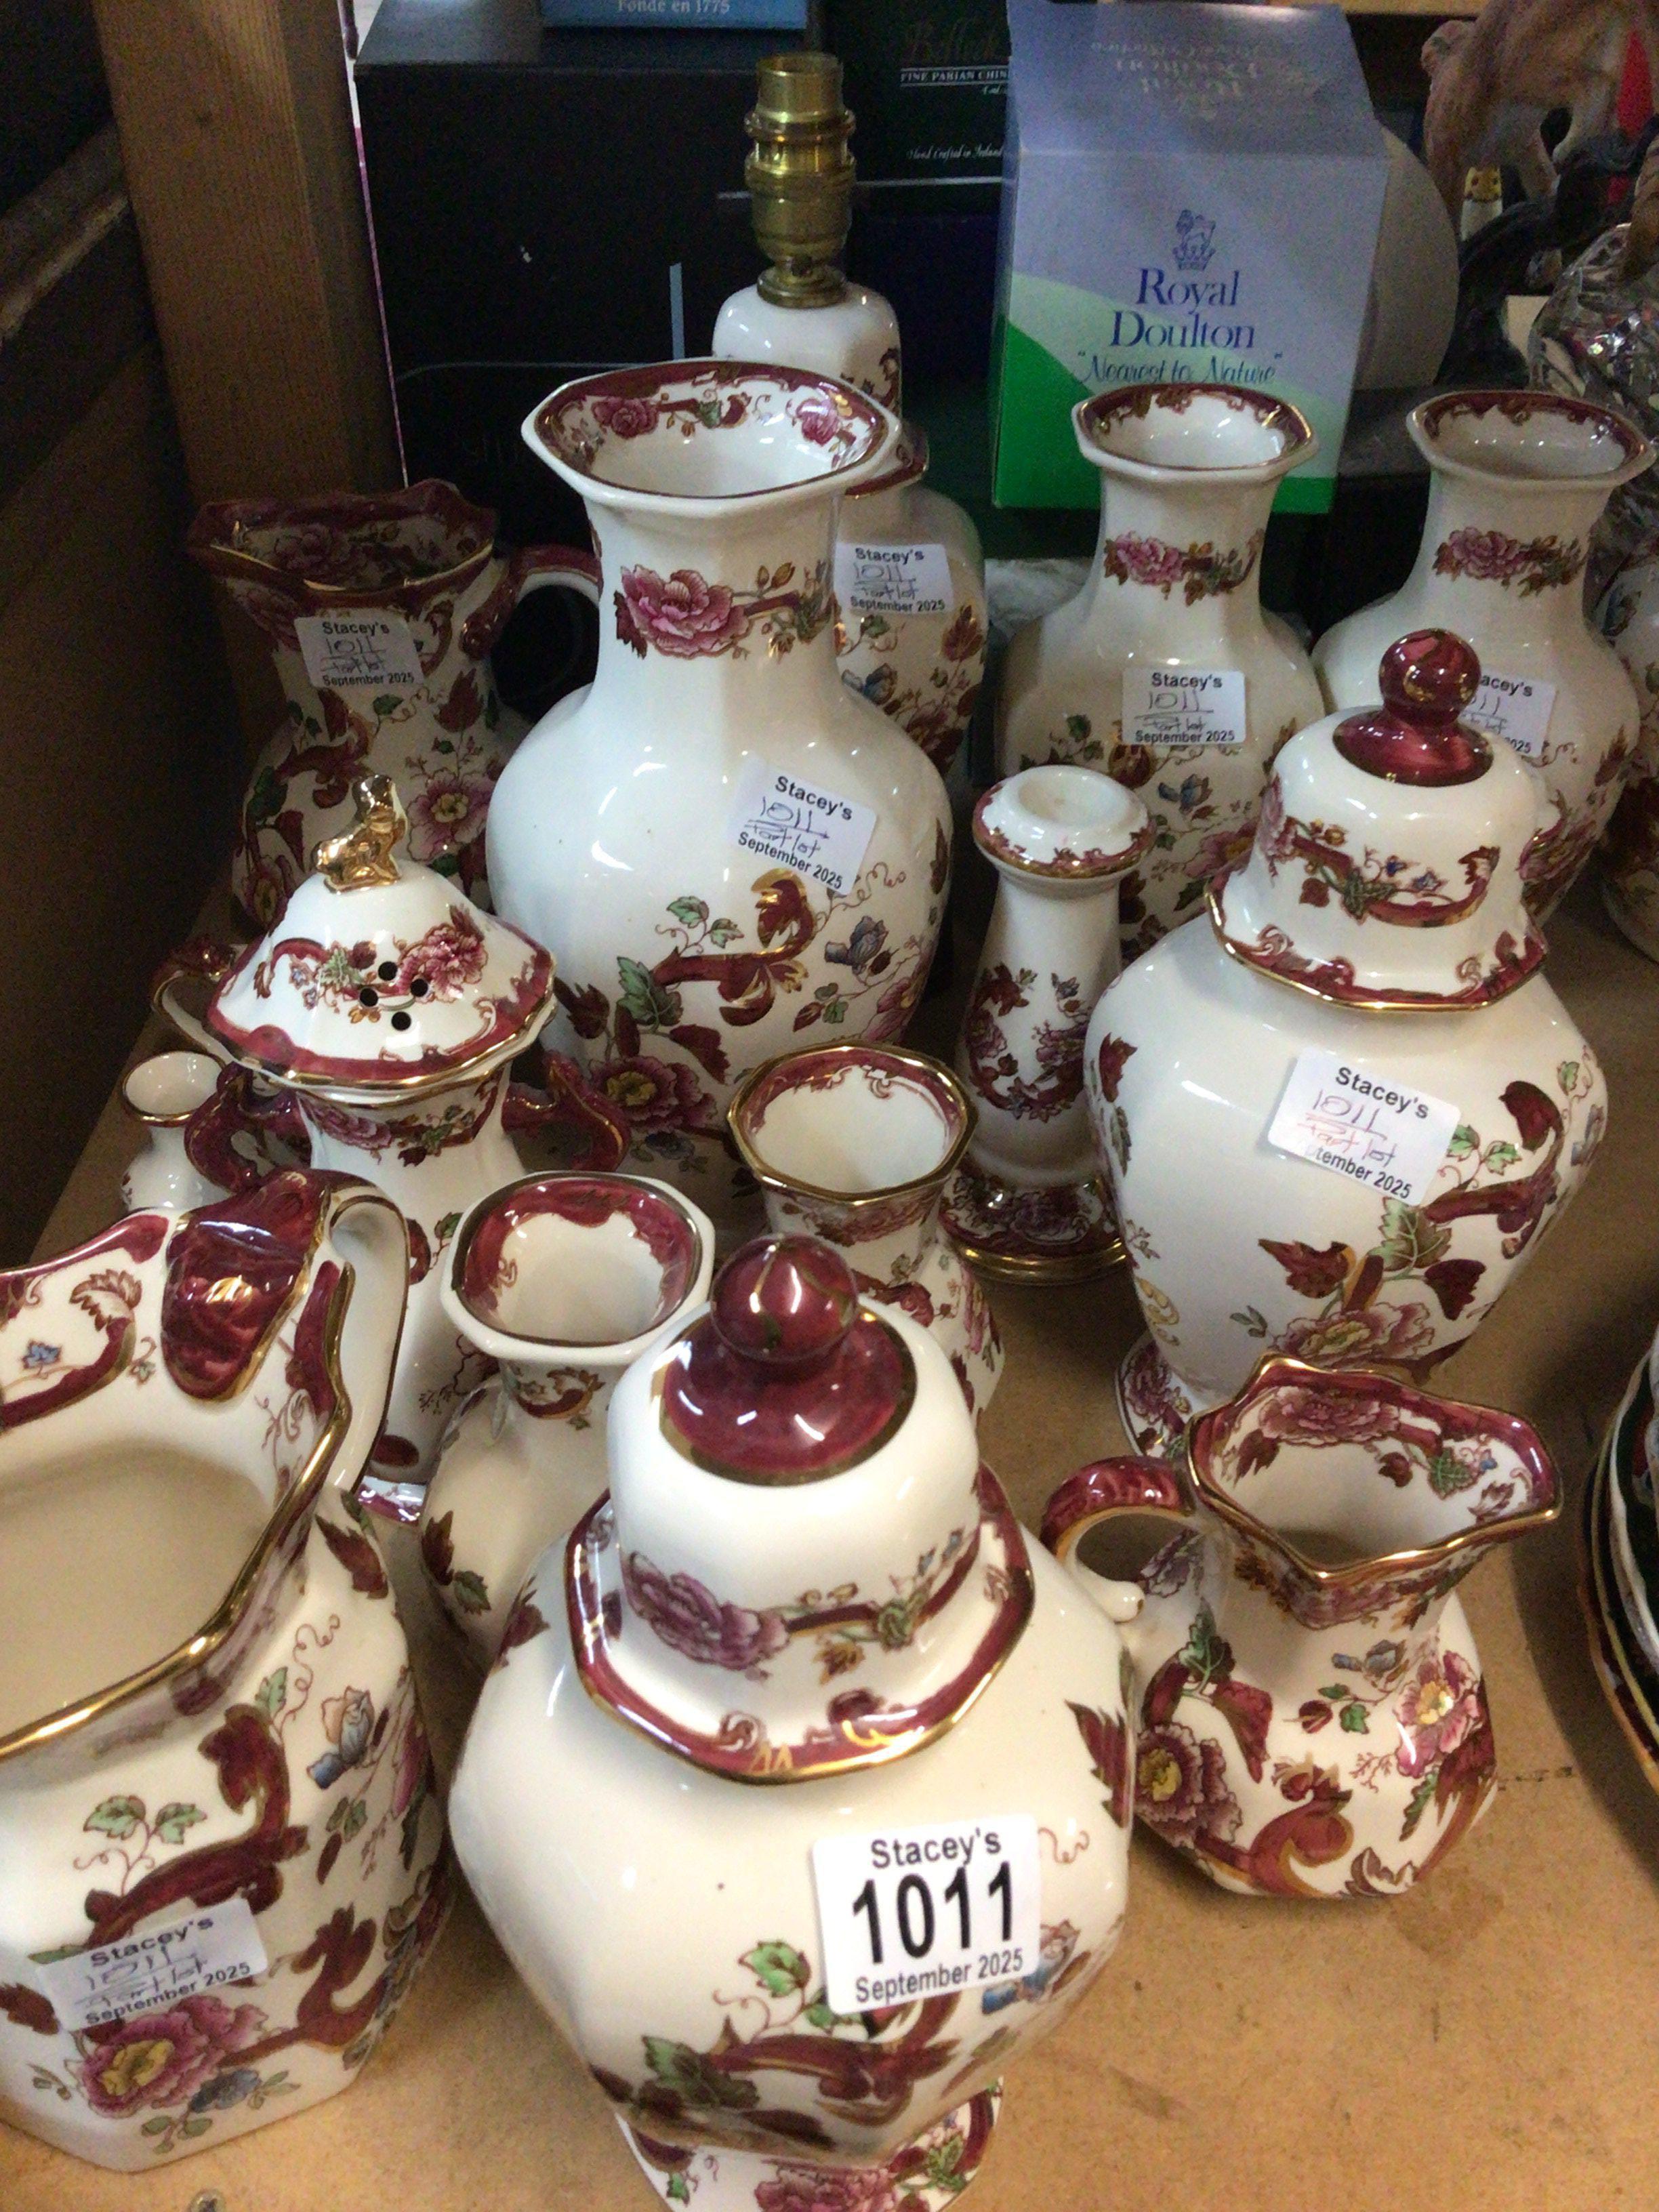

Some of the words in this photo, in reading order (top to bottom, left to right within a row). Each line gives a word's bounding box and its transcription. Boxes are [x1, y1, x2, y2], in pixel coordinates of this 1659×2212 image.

[672, 1, 691, 13] en
[696, 0, 731, 14] 1775
[899, 70, 928, 83] FINE
[932, 70, 976, 81] PARIAN
[978, 69, 1008, 81] CHIN
[1135, 268, 1240, 314] Royal
[1109, 310, 1255, 348] Doulton
[855, 547, 925, 565] Stacey's
[849, 596, 914, 611] September
[916, 598, 946, 613] 2025
[322, 621, 390, 636] Stacey's
[322, 673, 384, 687] September
[388, 672, 415, 684] 2025
[1151, 672, 1223, 691] Stacey's
[1480, 675, 1533, 697] acey's
[1134, 730, 1202, 744] September
[1205, 730, 1235, 743] 2025
[760, 795, 814, 834] 1011
[775, 775, 853, 821] Stacey's
[737, 831, 813, 873] September
[813, 864, 844, 890] 2025
[1312, 1088, 1380, 1133] 1011
[1334, 1066, 1429, 1120] Stacey's
[1373, 1170, 1413, 1200] 2025
[870, 1826, 1002, 1869] Stacey's
[852, 1861, 1012, 1965] 1011
[90, 1918, 214, 1966] Stacey's
[85, 1982, 197, 2025] September
[203, 1961, 251, 1988] 2025
[855, 1963, 972, 2005] September
[977, 1947, 1024, 1980] 2025
